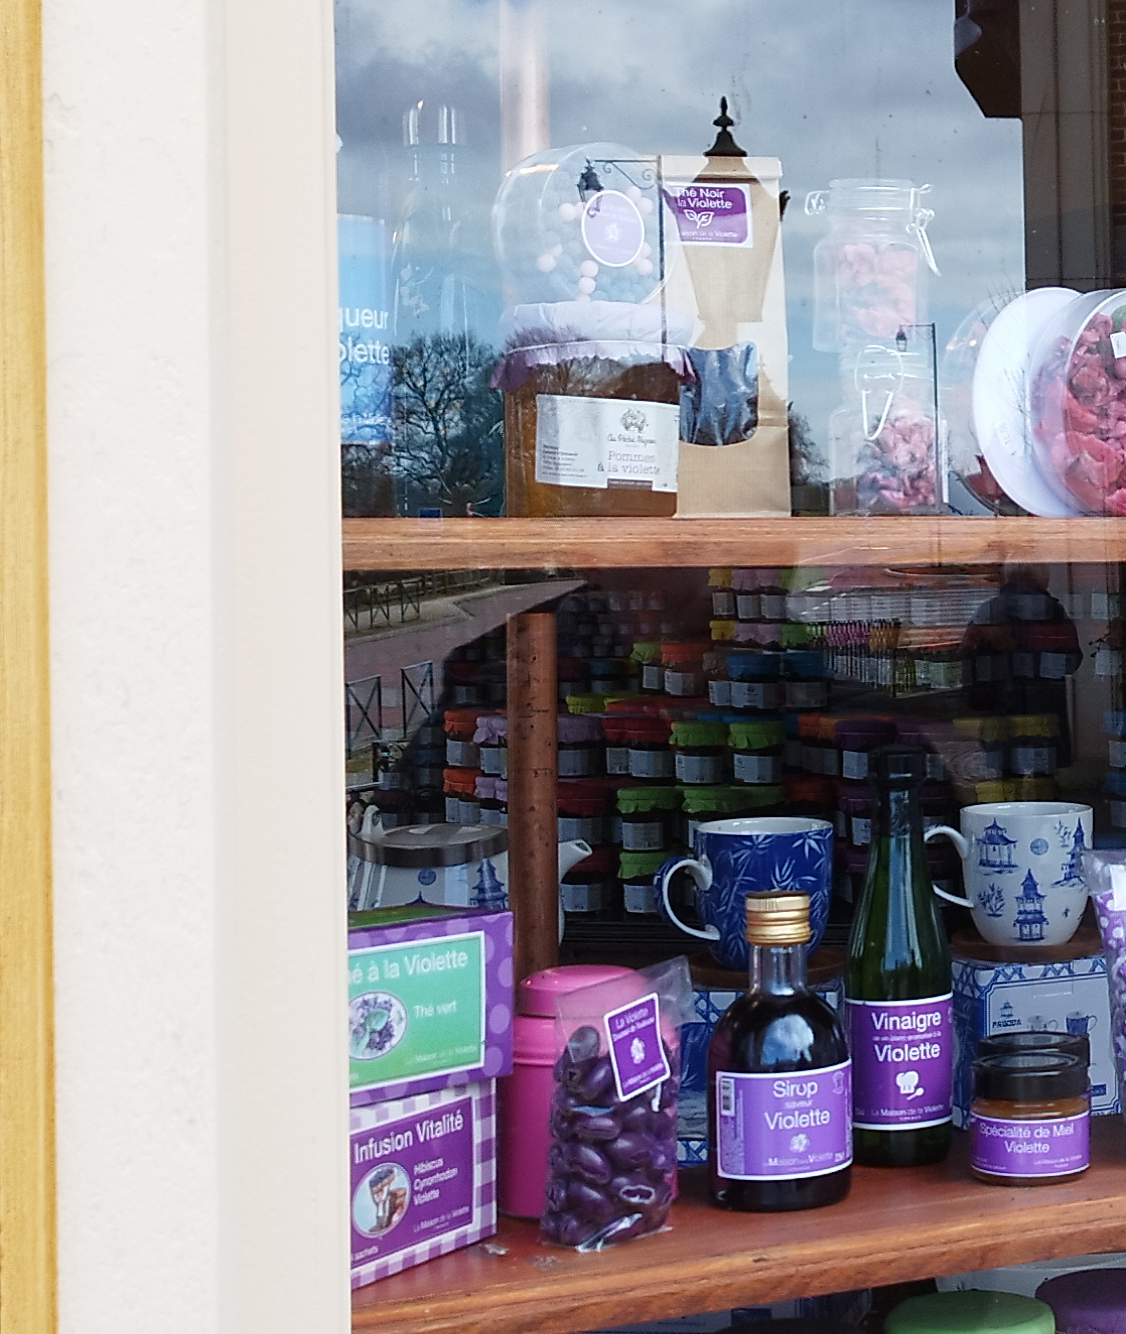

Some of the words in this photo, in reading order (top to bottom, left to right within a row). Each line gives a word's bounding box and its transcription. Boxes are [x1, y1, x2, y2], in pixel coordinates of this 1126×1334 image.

[368, 960, 380, 983] à
[384, 959, 400, 980] la
[403, 949, 469, 976] Violette
[413, 1003, 433, 1019] Thé
[436, 999, 458, 1015] vert
[870, 1010, 942, 1033] Vinaigre
[873, 1041, 941, 1063] Violette
[772, 1080, 818, 1098] Sirop
[416, 1108, 464, 1144] Vitalité
[764, 1108, 831, 1130] Violette
[979, 1122, 1031, 1139] Spécialité
[1033, 1125, 1050, 1138] de
[1053, 1123, 1074, 1137] Miel
[354, 1130, 413, 1164] Infusion
[1004, 1140, 1050, 1154] Violette
